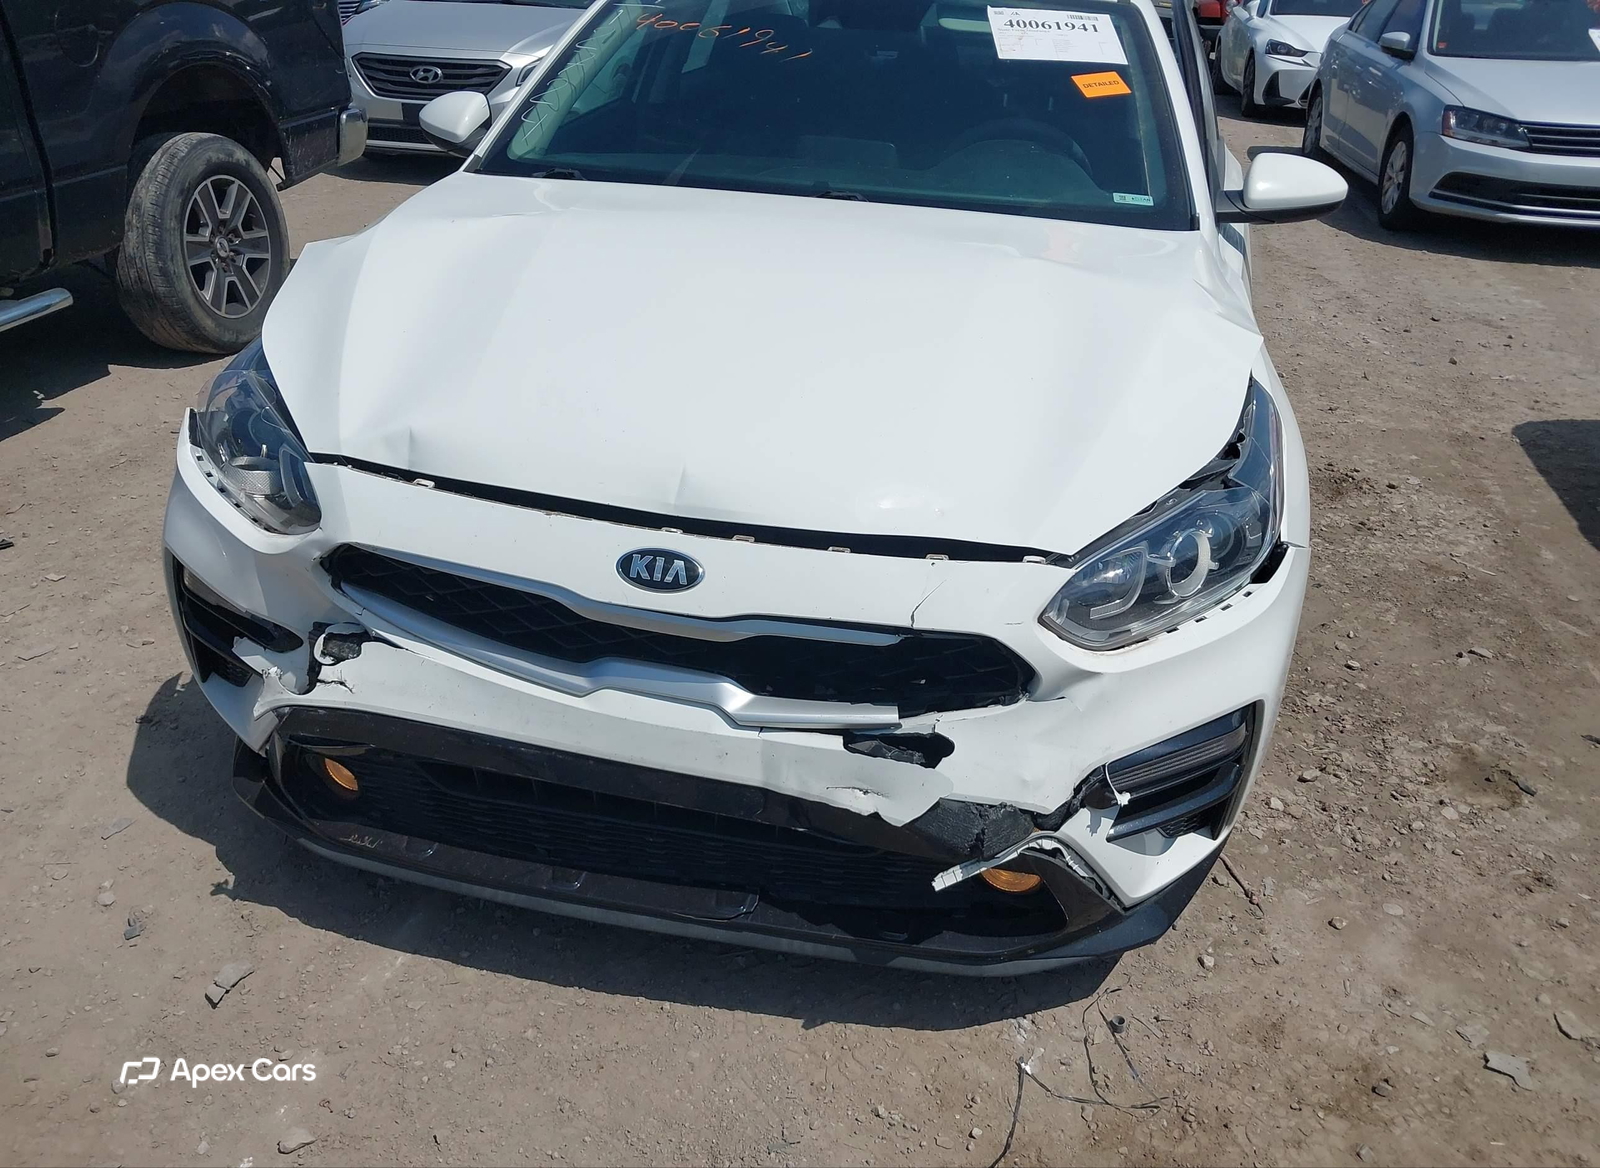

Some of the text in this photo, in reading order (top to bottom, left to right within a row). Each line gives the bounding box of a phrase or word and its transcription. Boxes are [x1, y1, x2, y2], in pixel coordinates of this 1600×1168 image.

[1003, 19, 1099, 32] 40061941
[1082, 80, 1120, 89] DETAILED
[629, 553, 688, 585] KIA
